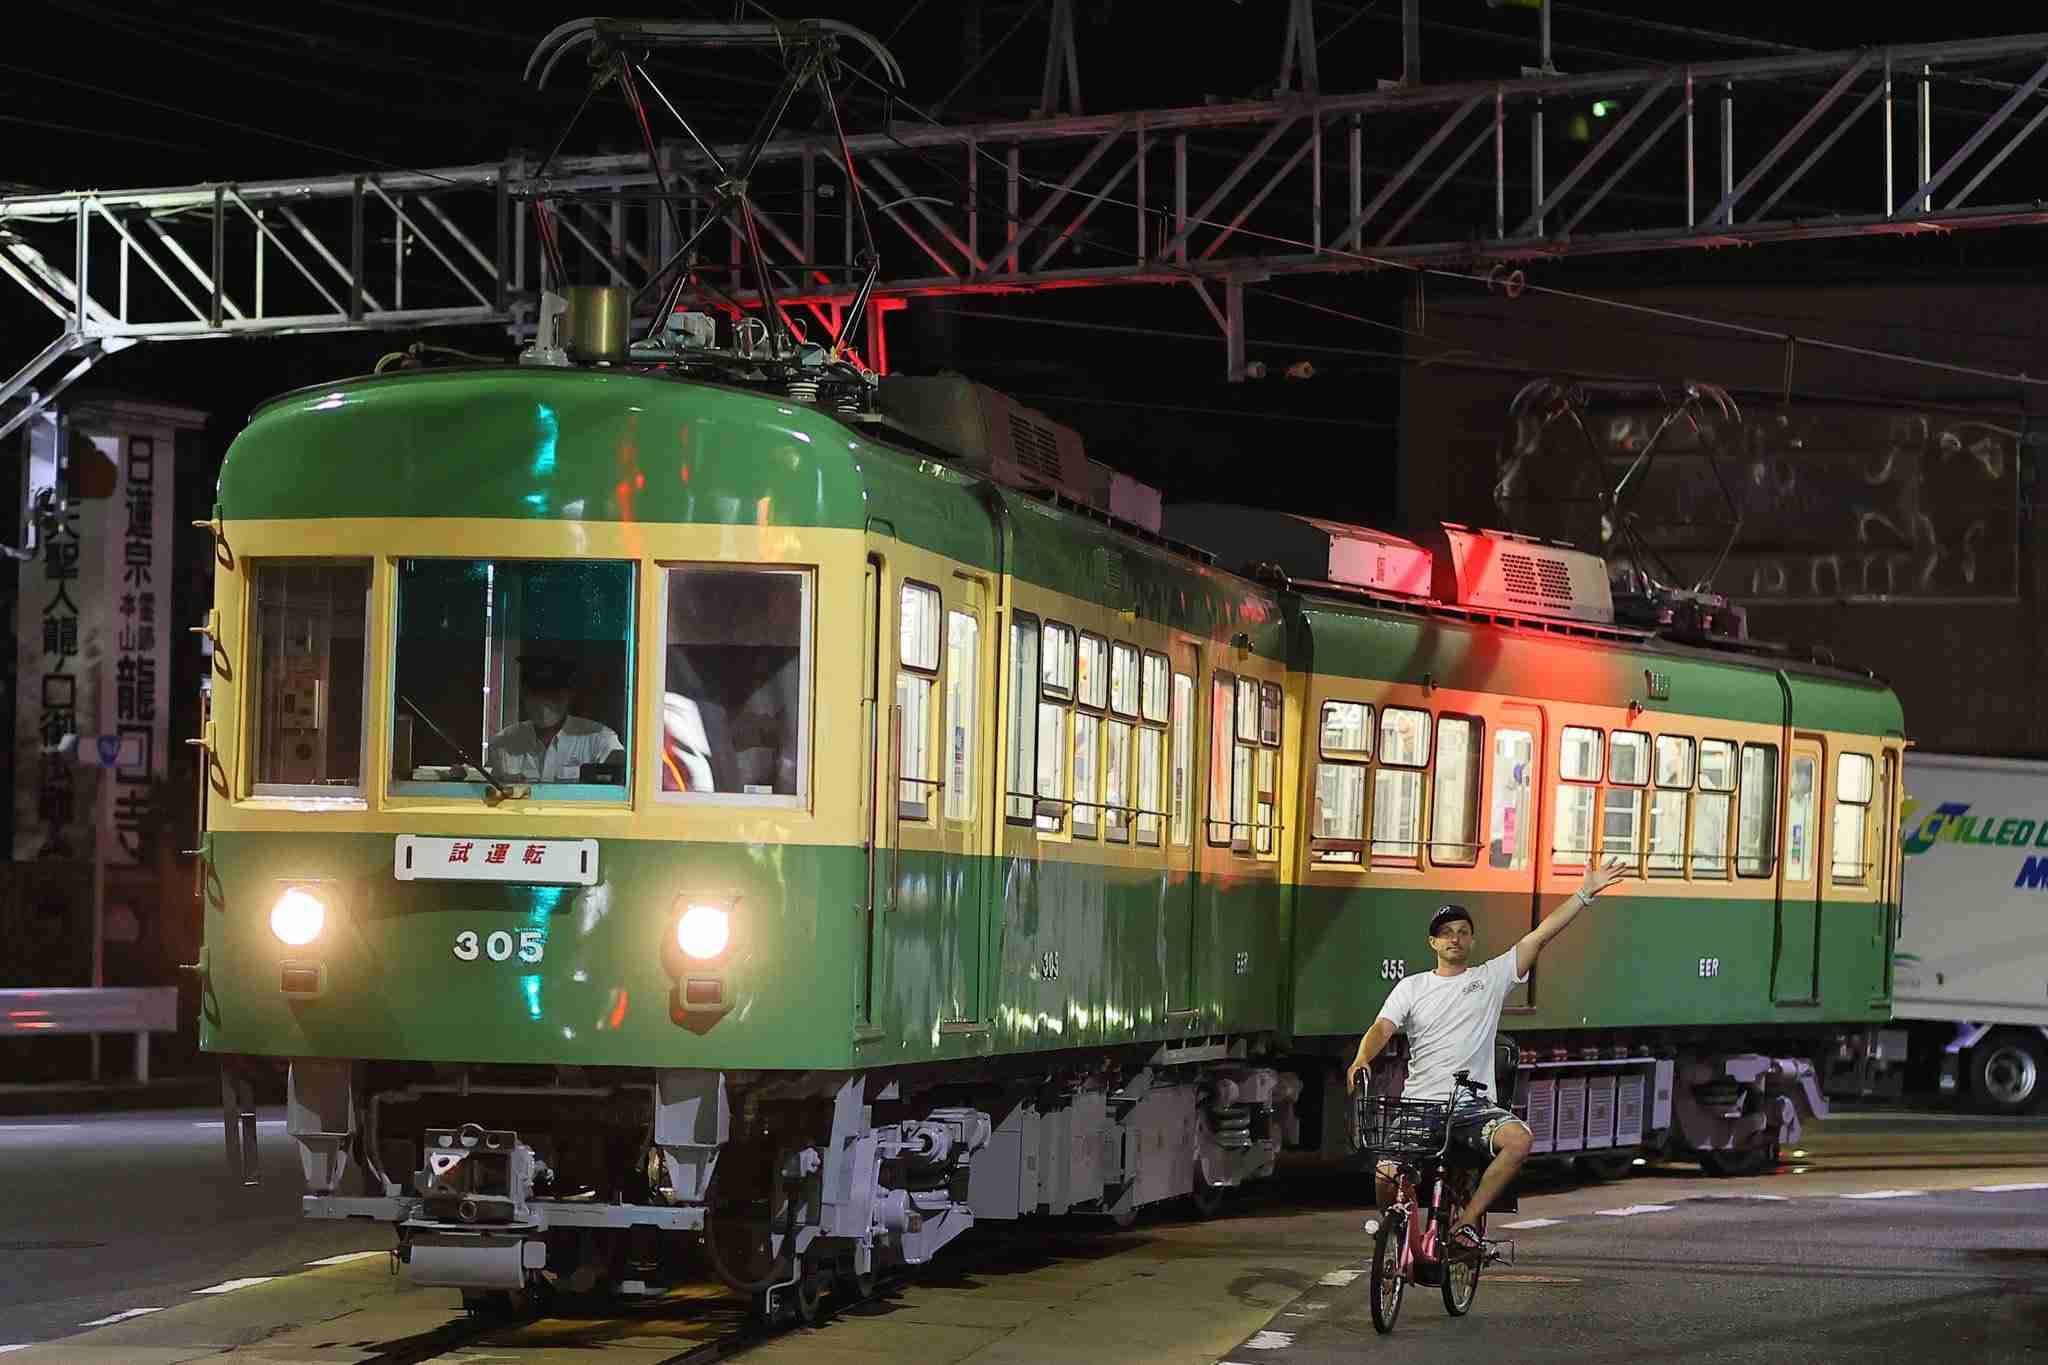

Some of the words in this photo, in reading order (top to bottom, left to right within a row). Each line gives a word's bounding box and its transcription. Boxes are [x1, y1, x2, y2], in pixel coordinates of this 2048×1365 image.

[448, 842, 547, 865] 試運転
[453, 930, 544, 962] 305
[1381, 959, 1405, 980] 355
[1699, 958, 1719, 976] EER
